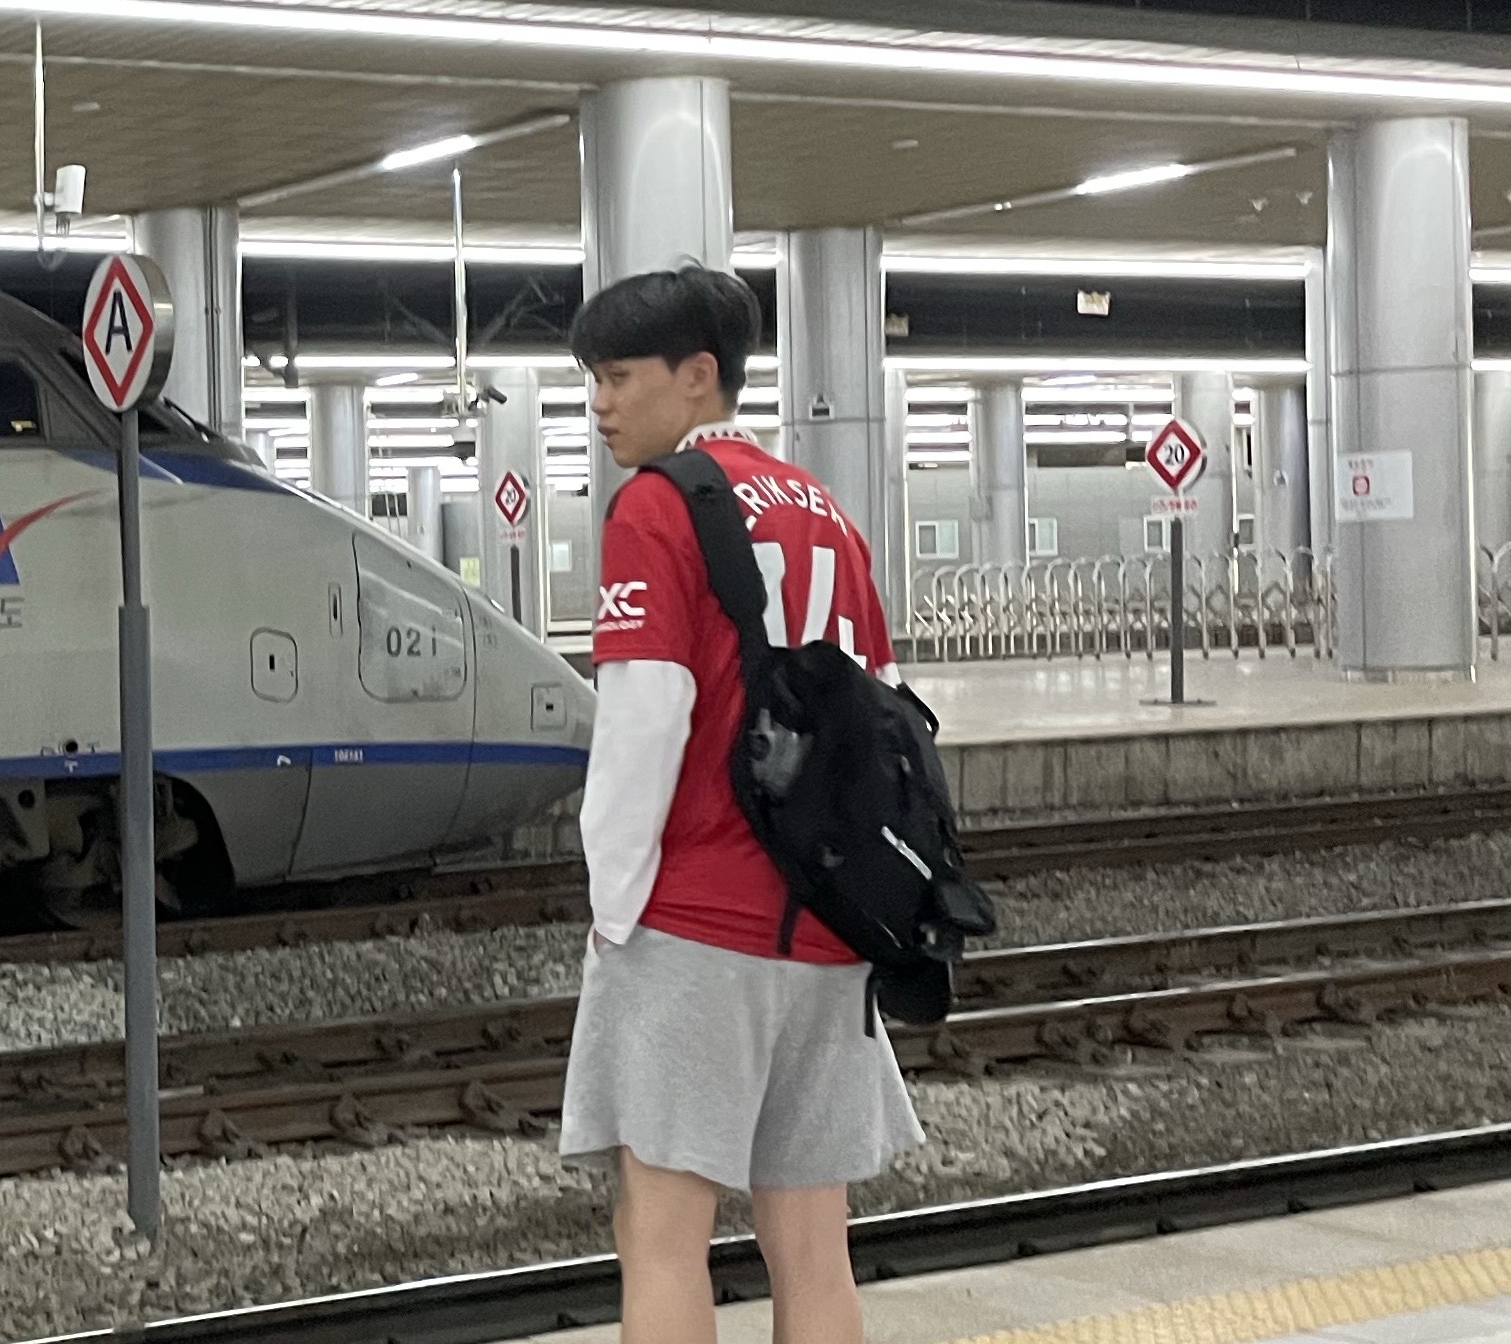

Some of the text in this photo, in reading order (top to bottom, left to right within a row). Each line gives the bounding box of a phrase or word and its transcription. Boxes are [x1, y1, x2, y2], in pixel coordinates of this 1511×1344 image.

[105, 289, 132, 355] A
[1164, 443, 1185, 466] 20
[386, 625, 437, 658] 021
